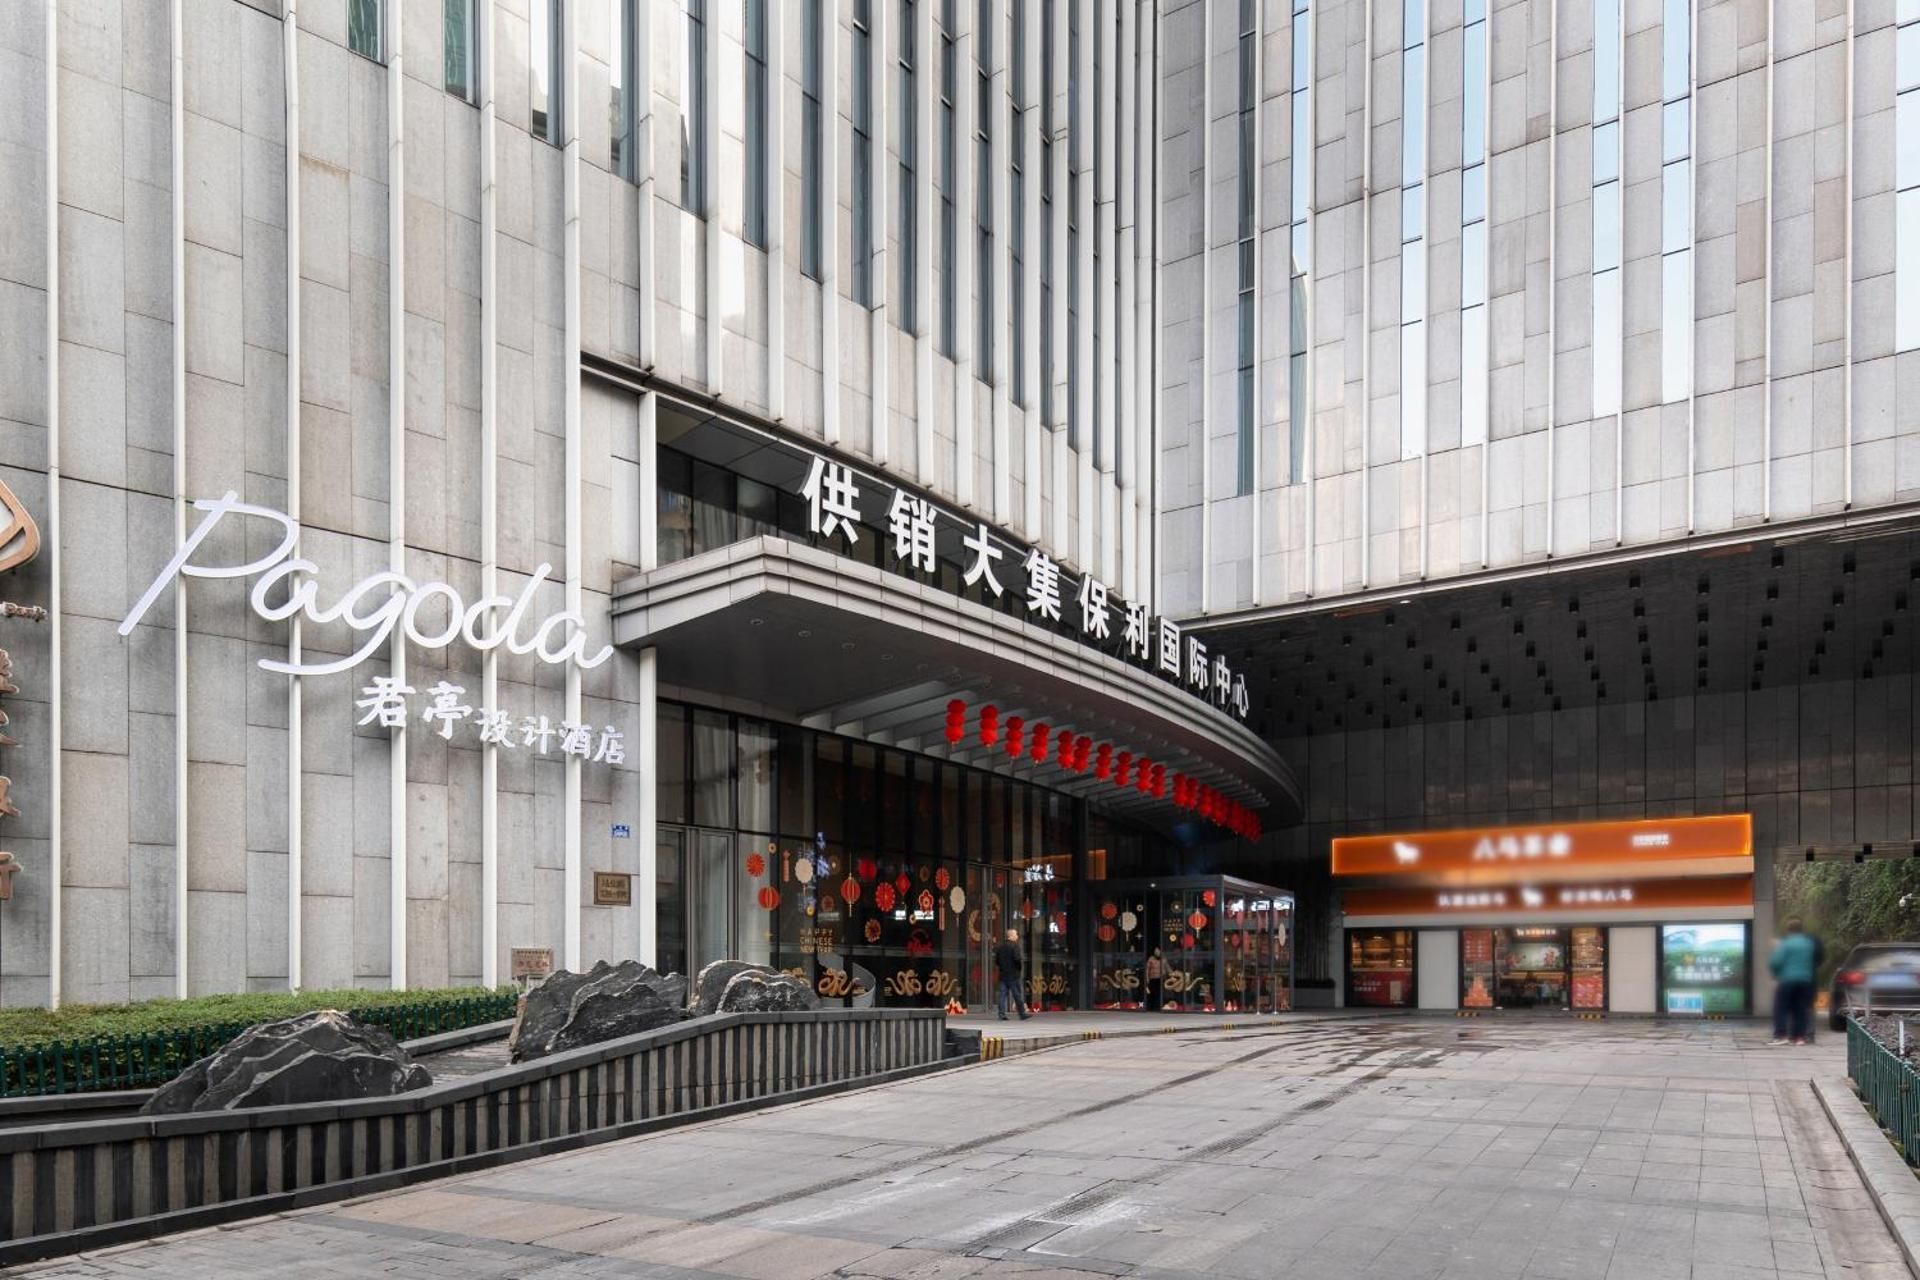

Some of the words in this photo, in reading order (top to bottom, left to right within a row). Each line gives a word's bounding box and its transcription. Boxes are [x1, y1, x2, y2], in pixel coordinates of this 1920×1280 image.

[118, 490, 614, 676] Pagoda
[797, 456, 1250, 719] 供销大集保利国际中心
[355, 676, 626, 765] 君亭设计酒店
[800, 936, 833, 946] CHINESE
